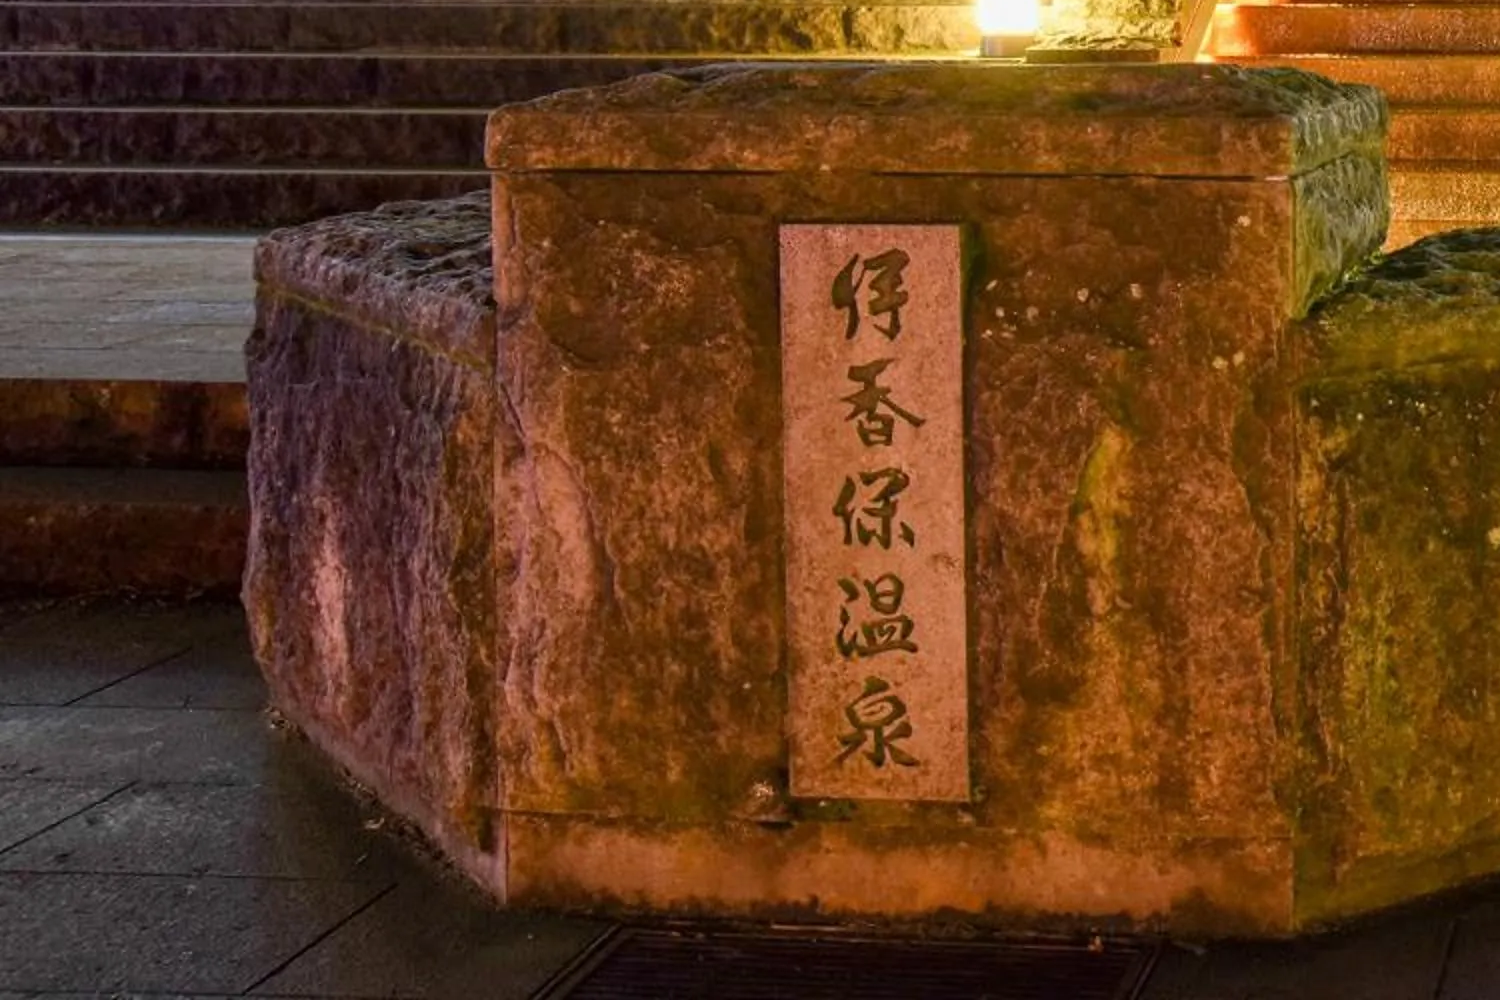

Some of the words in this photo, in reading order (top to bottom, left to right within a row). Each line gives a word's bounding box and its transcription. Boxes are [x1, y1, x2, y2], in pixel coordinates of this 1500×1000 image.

[831, 247, 927, 768] 伊香保温泉
